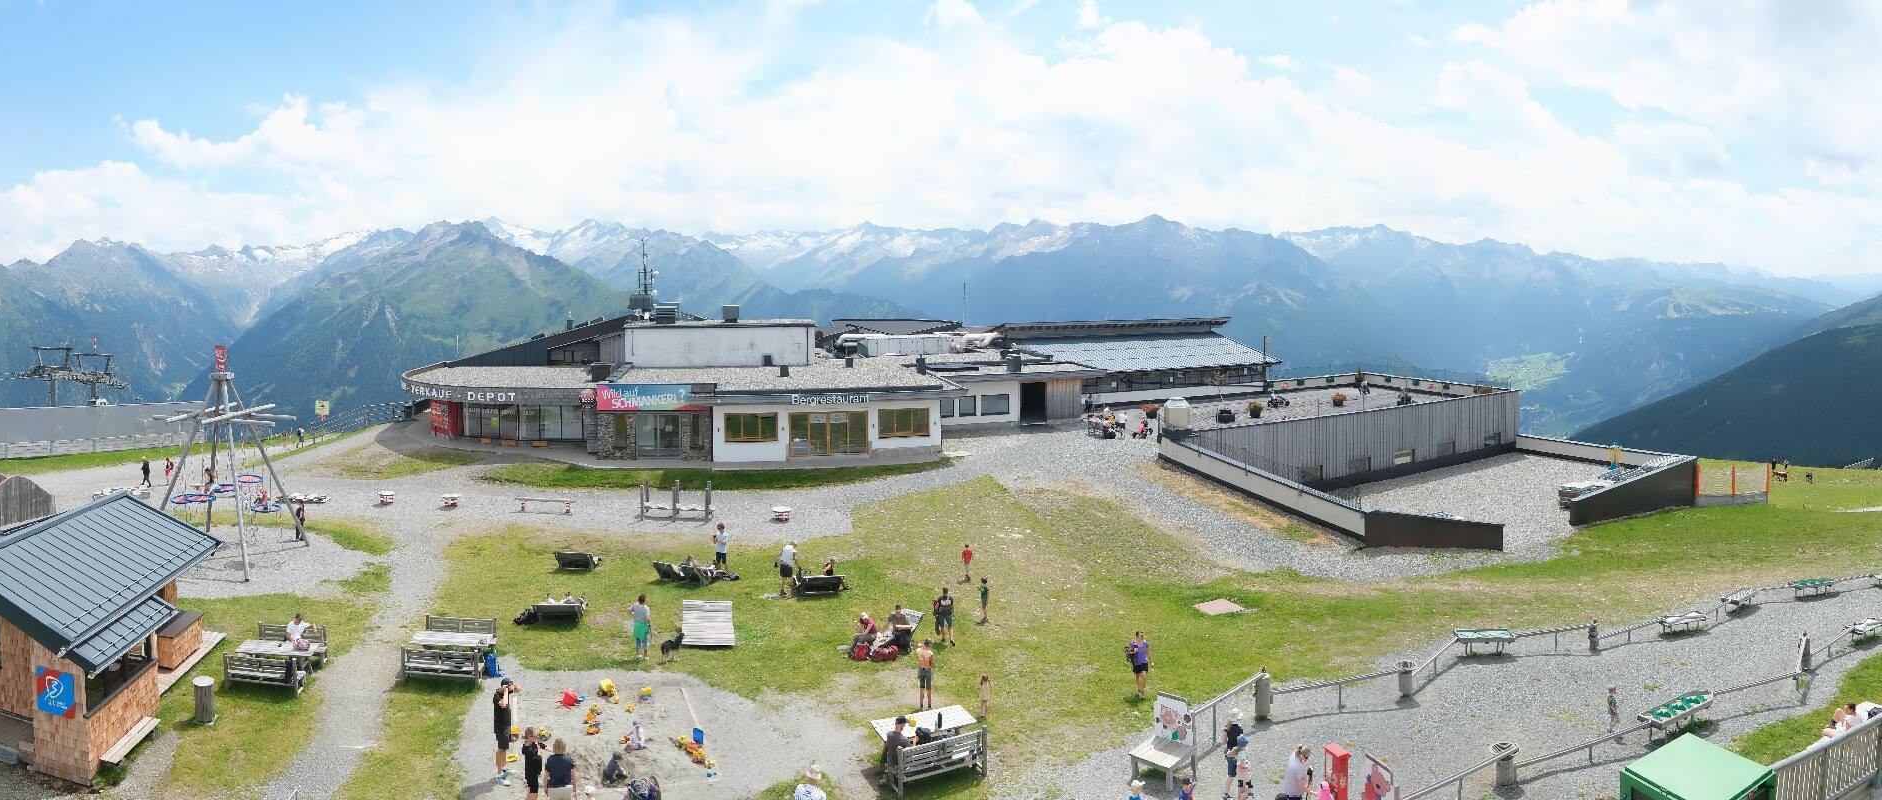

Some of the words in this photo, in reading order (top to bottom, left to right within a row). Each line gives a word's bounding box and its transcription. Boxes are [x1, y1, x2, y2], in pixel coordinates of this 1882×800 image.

[411, 385, 452, 399] VERKAUF
[467, 392, 516, 401] DEPOT
[601, 388, 622, 400] Wild
[623, 386, 639, 398] auf
[791, 394, 870, 406] Bergrestaurant
[611, 393, 680, 409] SCHMANKERL
